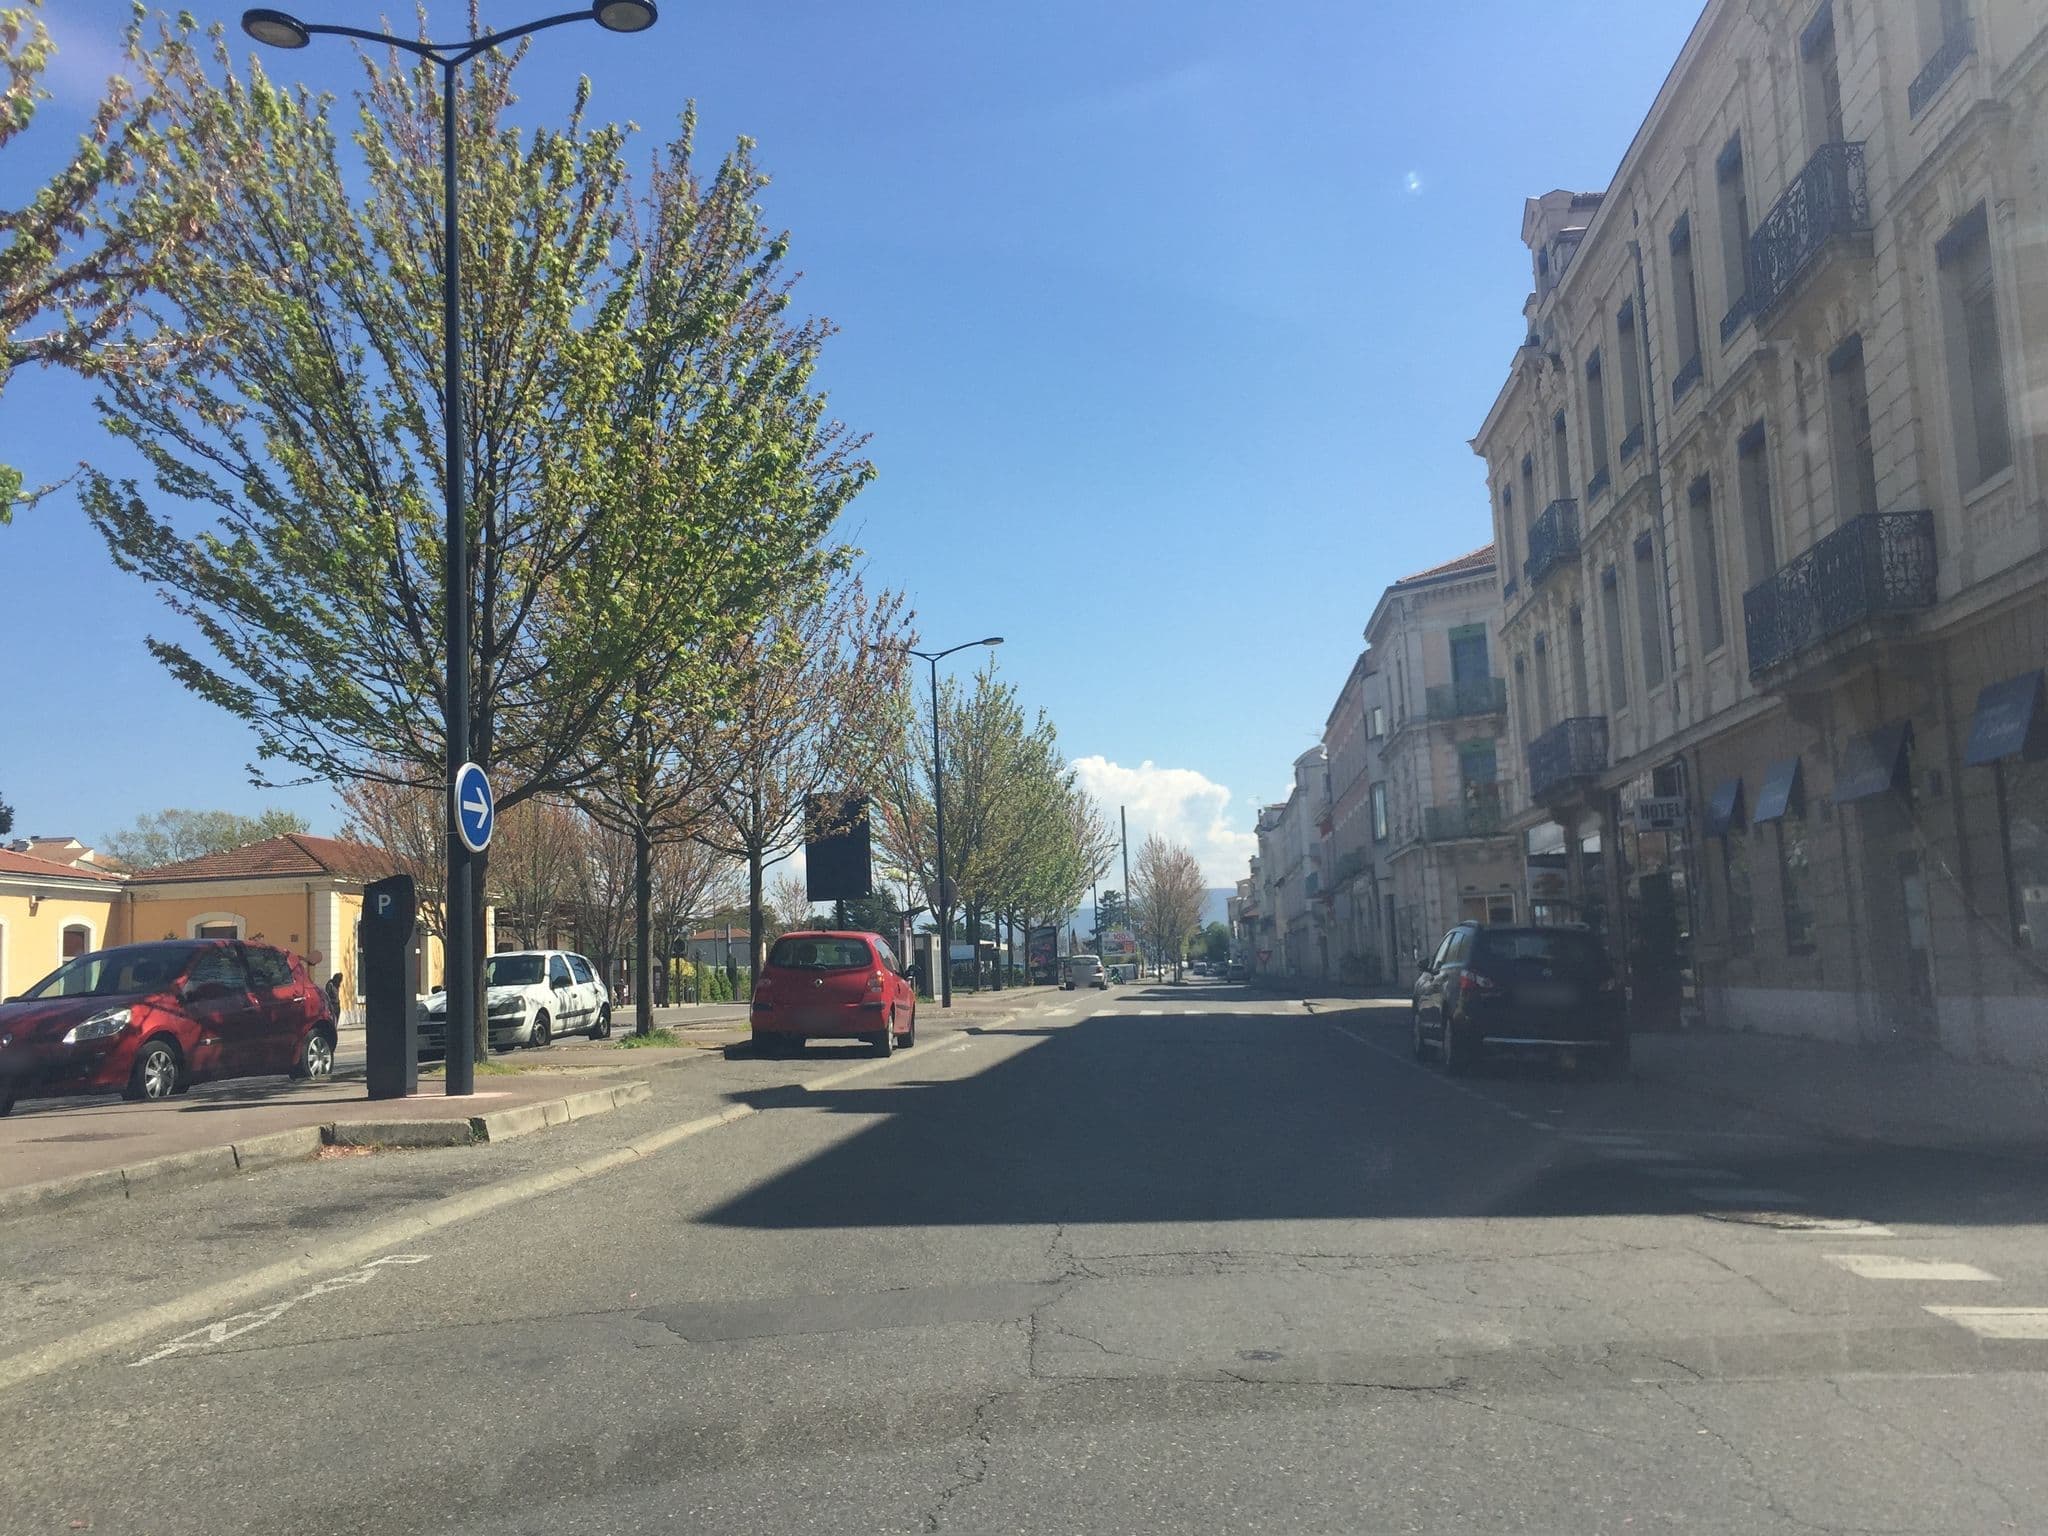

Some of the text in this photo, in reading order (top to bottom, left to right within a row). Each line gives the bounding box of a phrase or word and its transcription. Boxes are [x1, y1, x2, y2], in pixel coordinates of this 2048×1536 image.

[1640, 802, 1680, 820] HOTEL
[378, 894, 391, 915] P
[127, 1254, 433, 1367] PAYANT
